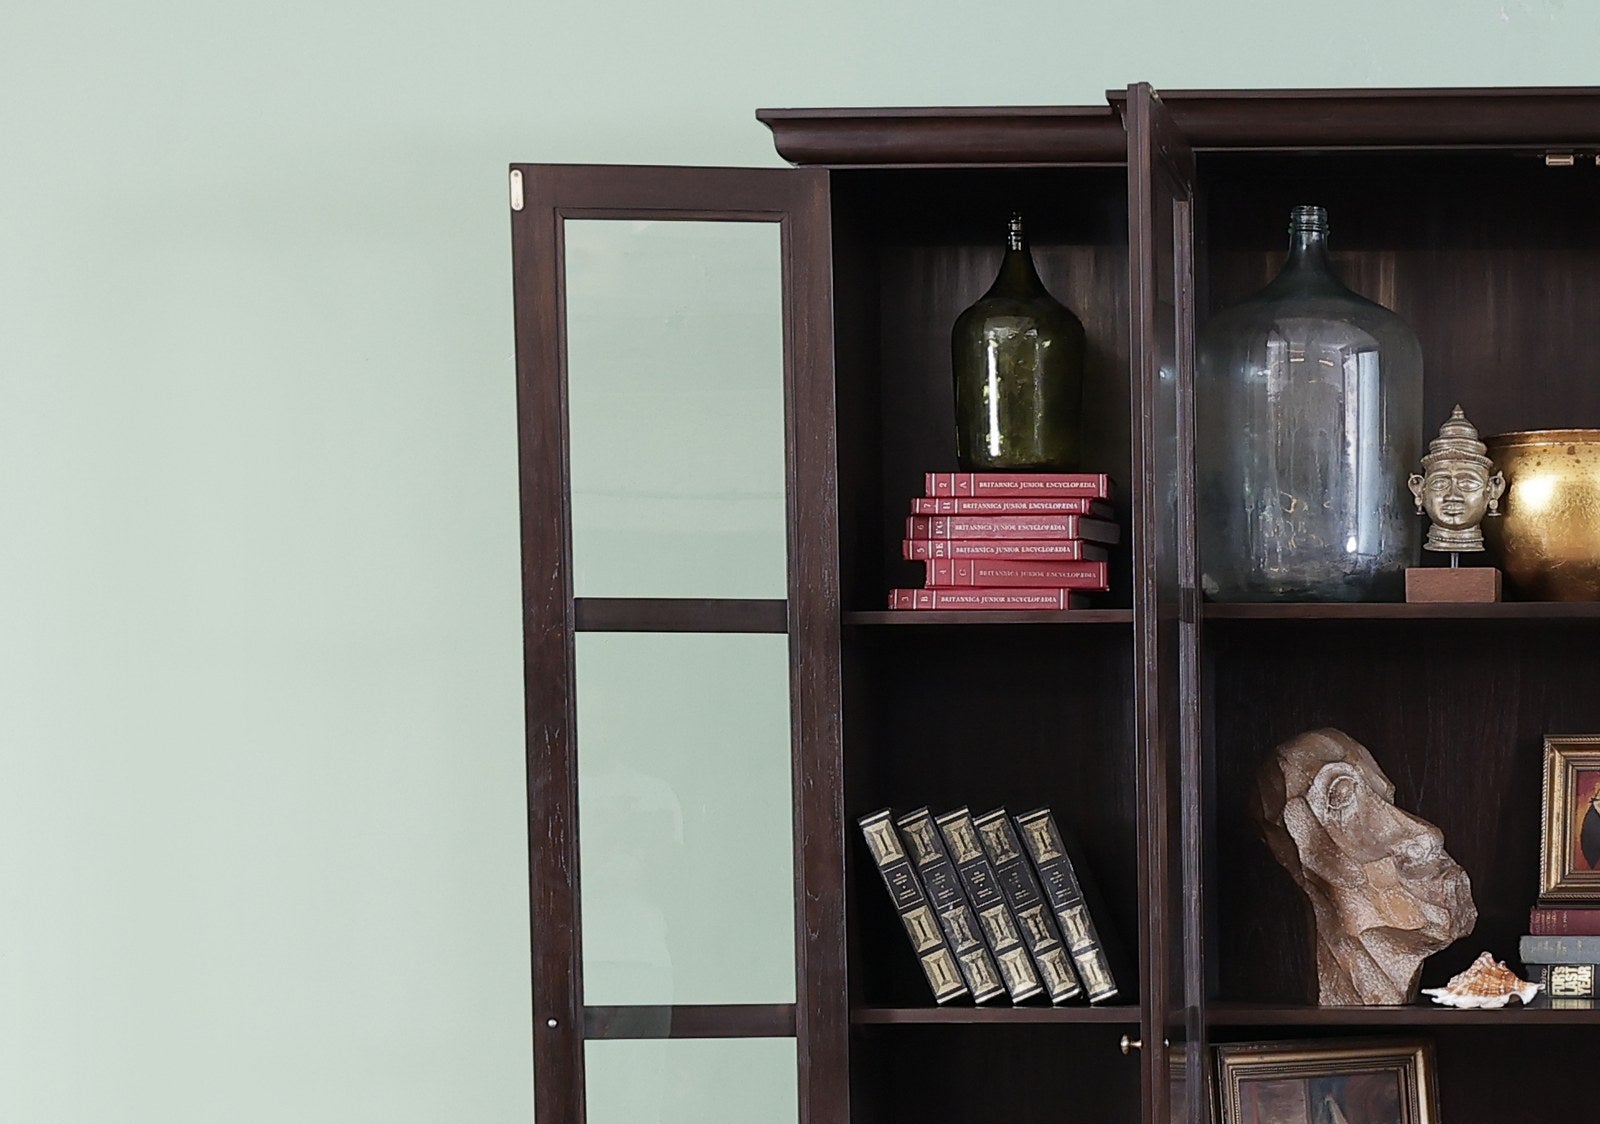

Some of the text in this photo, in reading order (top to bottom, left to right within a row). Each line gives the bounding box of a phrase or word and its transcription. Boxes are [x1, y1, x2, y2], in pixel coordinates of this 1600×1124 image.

[962, 502, 1002, 510] BRITANNICA
[1002, 502, 1027, 510] JUNIOR
[936, 521, 943, 534] FG
[936, 543, 943, 557] DE
[1565, 966, 1578, 995] LAST
[1578, 966, 1591, 995] YEAR
